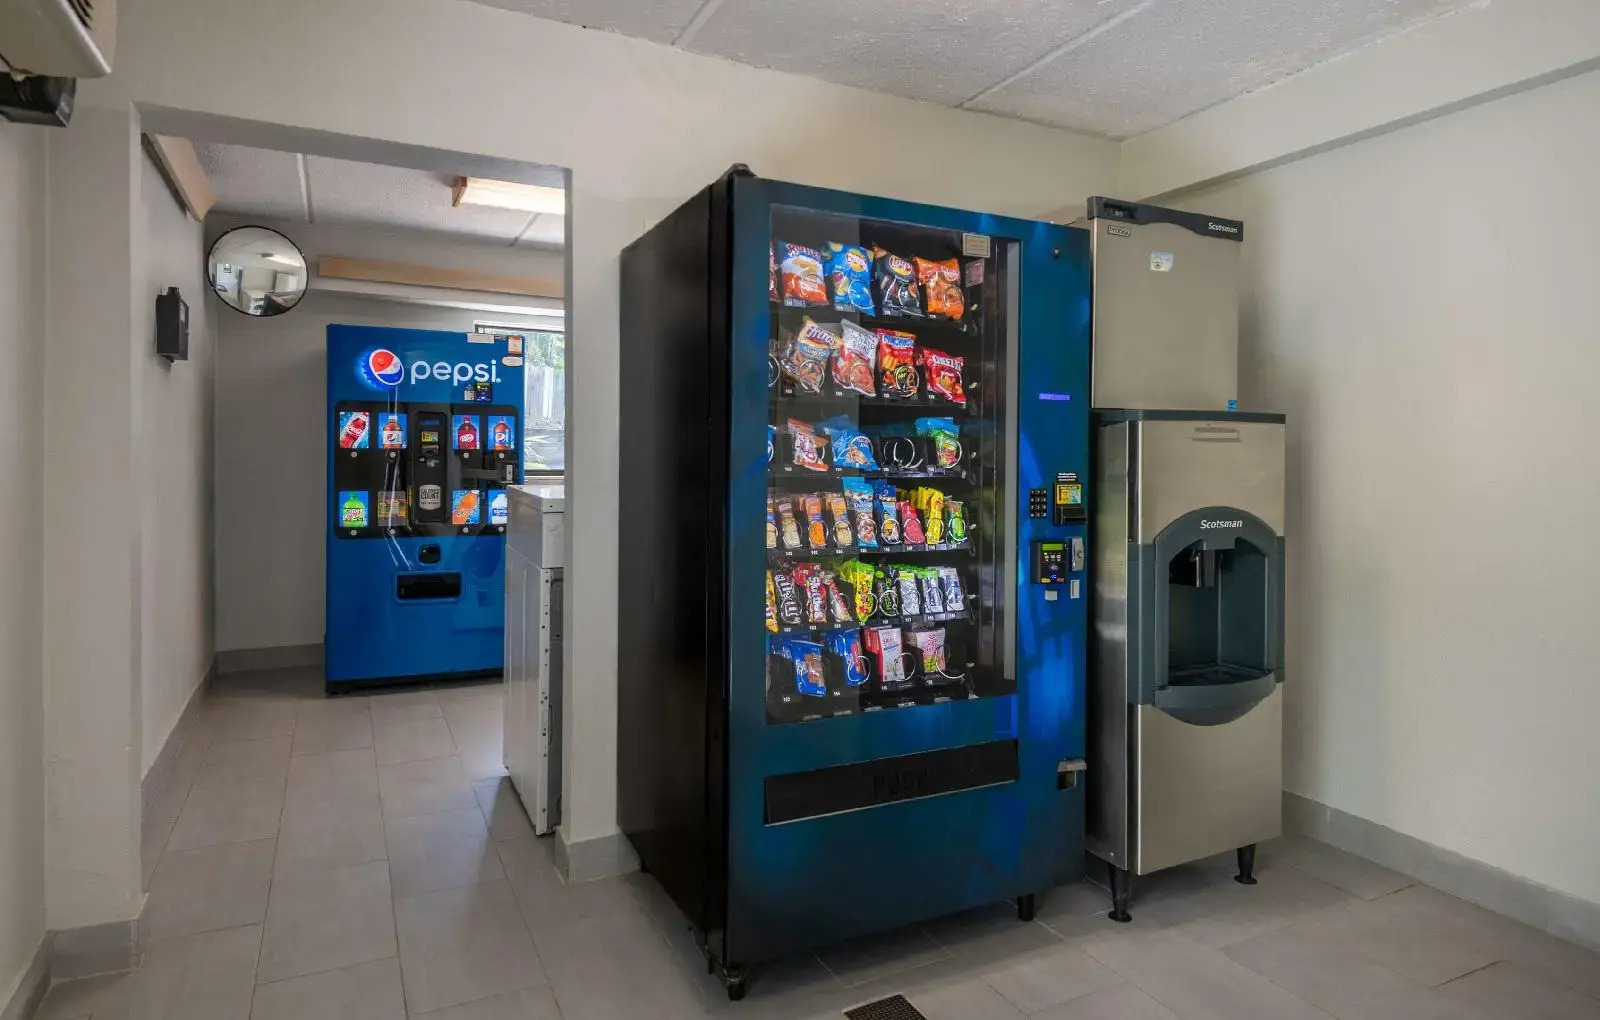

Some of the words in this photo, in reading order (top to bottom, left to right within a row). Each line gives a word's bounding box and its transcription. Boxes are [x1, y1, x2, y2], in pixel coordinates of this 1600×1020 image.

[1207, 221, 1239, 235] Scotsman
[410, 359, 500, 387] pepsi
[1200, 519, 1243, 530] Scotsman
